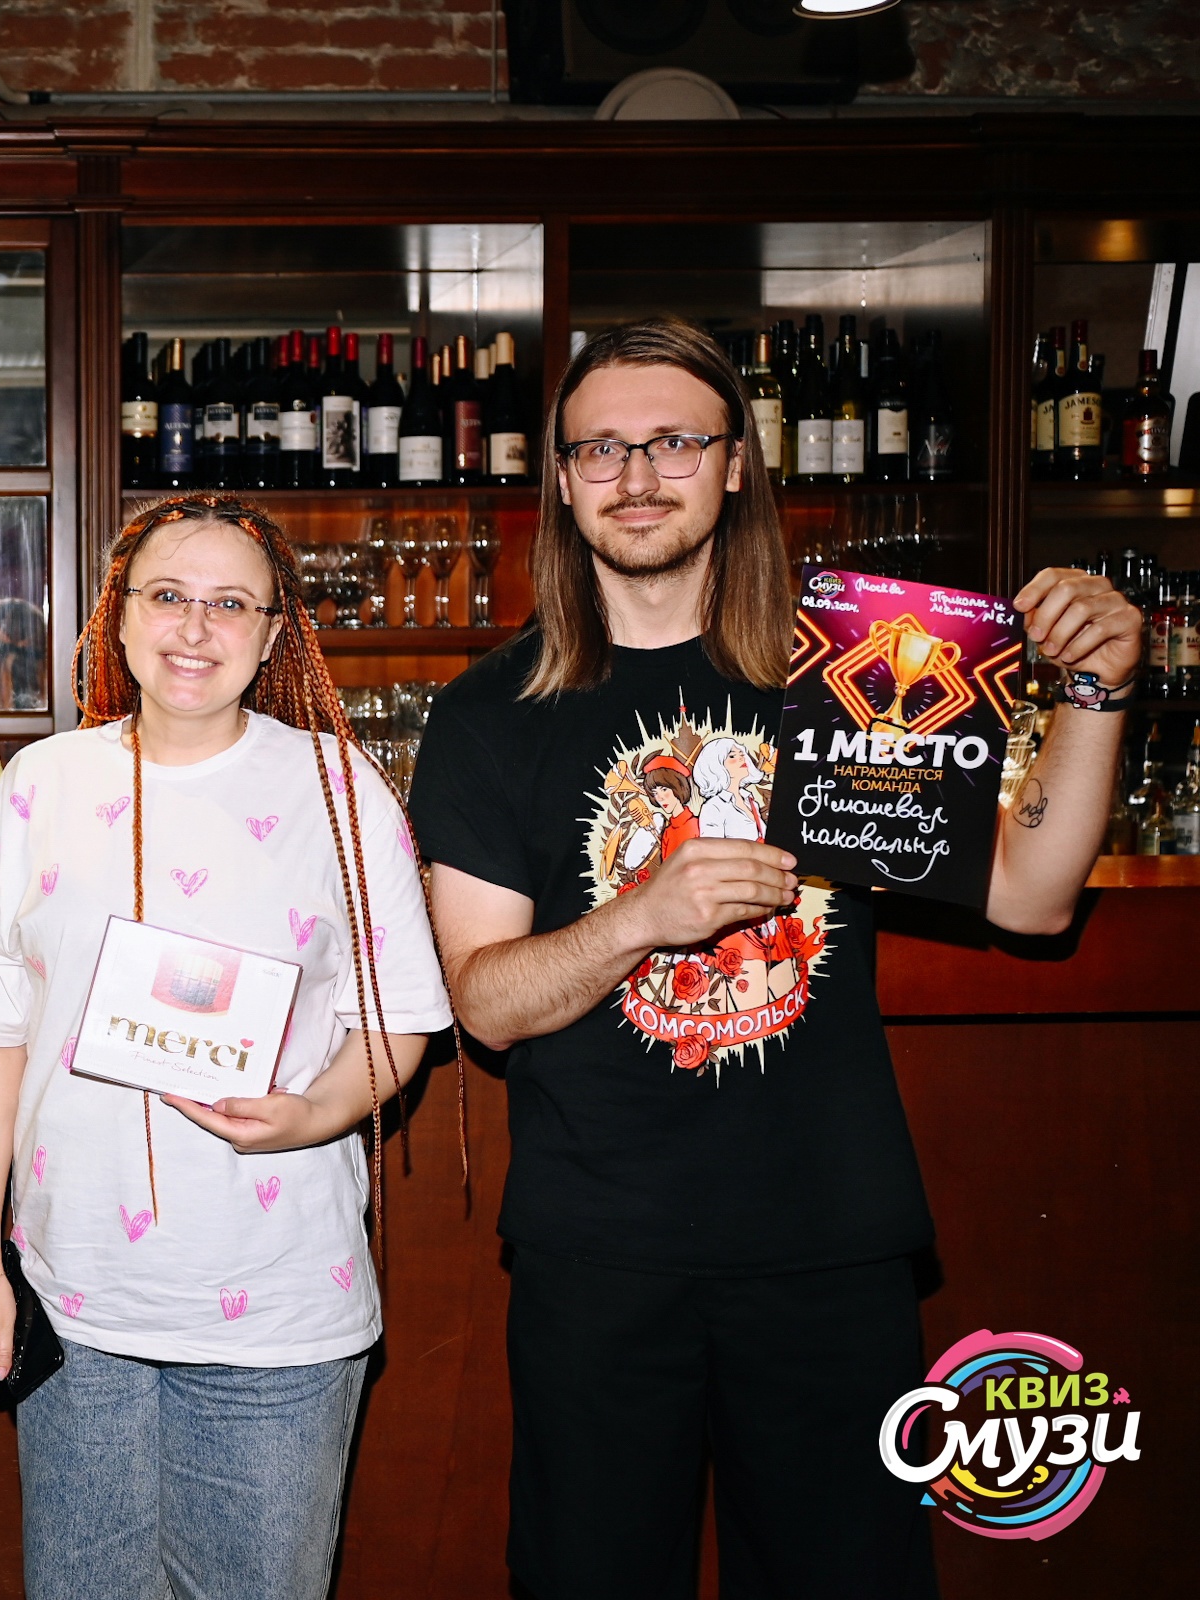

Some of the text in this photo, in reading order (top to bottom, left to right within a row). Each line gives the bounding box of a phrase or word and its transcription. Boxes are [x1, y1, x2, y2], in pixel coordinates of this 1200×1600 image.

[808, 576, 846, 593] Смузи
[855, 577, 905, 596] Москва
[929, 590, 1007, 612] Приколы и
[793, 727, 990, 770] 1 МЕСТО
[833, 763, 944, 782] НАГРАЖДАЕТСЯ
[850, 778, 922, 794] КОМАНДА
[624, 982, 808, 1043] КОМСОМОЛЬСК
[107, 1014, 256, 1073] merci
[171, 1062, 220, 1082] Selection
